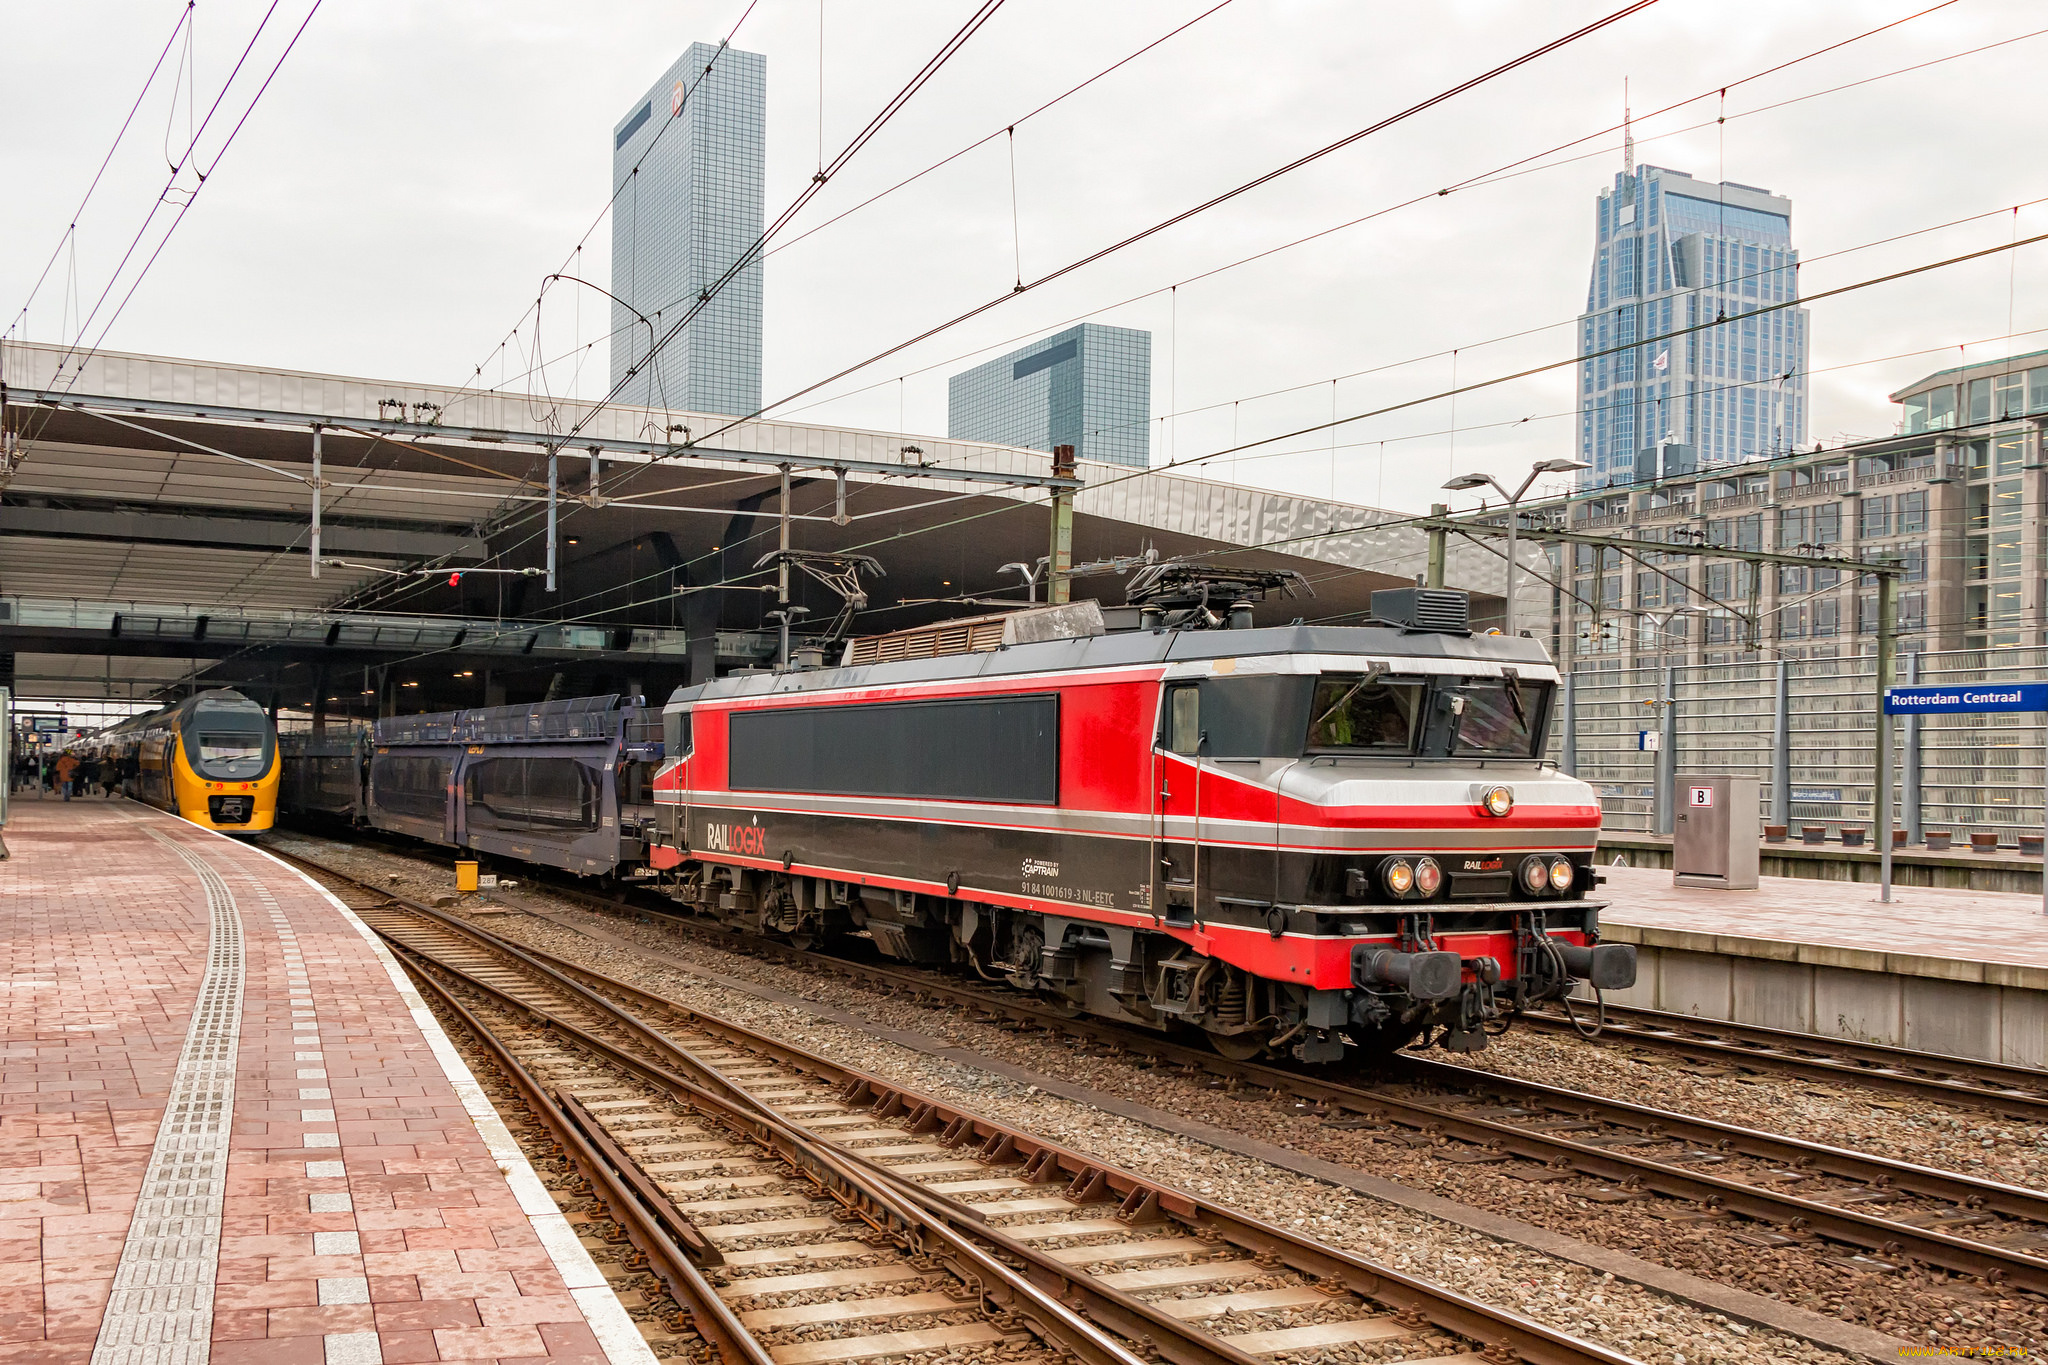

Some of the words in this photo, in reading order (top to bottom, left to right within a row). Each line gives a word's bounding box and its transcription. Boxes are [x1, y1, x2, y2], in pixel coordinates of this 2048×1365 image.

[1892, 693, 1960, 706] Rotterdam
[1963, 690, 2022, 704] Centraal
[1697, 790, 1705, 804] B
[707, 814, 765, 856] RAILLOGIX
[1024, 864, 1059, 877] CAPTRAIN
[1463, 857, 1504, 870] RAILLOGIX
[1021, 881, 1030, 893] 91
[1031, 883, 1041, 895] 84
[1042, 884, 1073, 900] 1001619
[1082, 889, 1115, 906] NL-EETC
